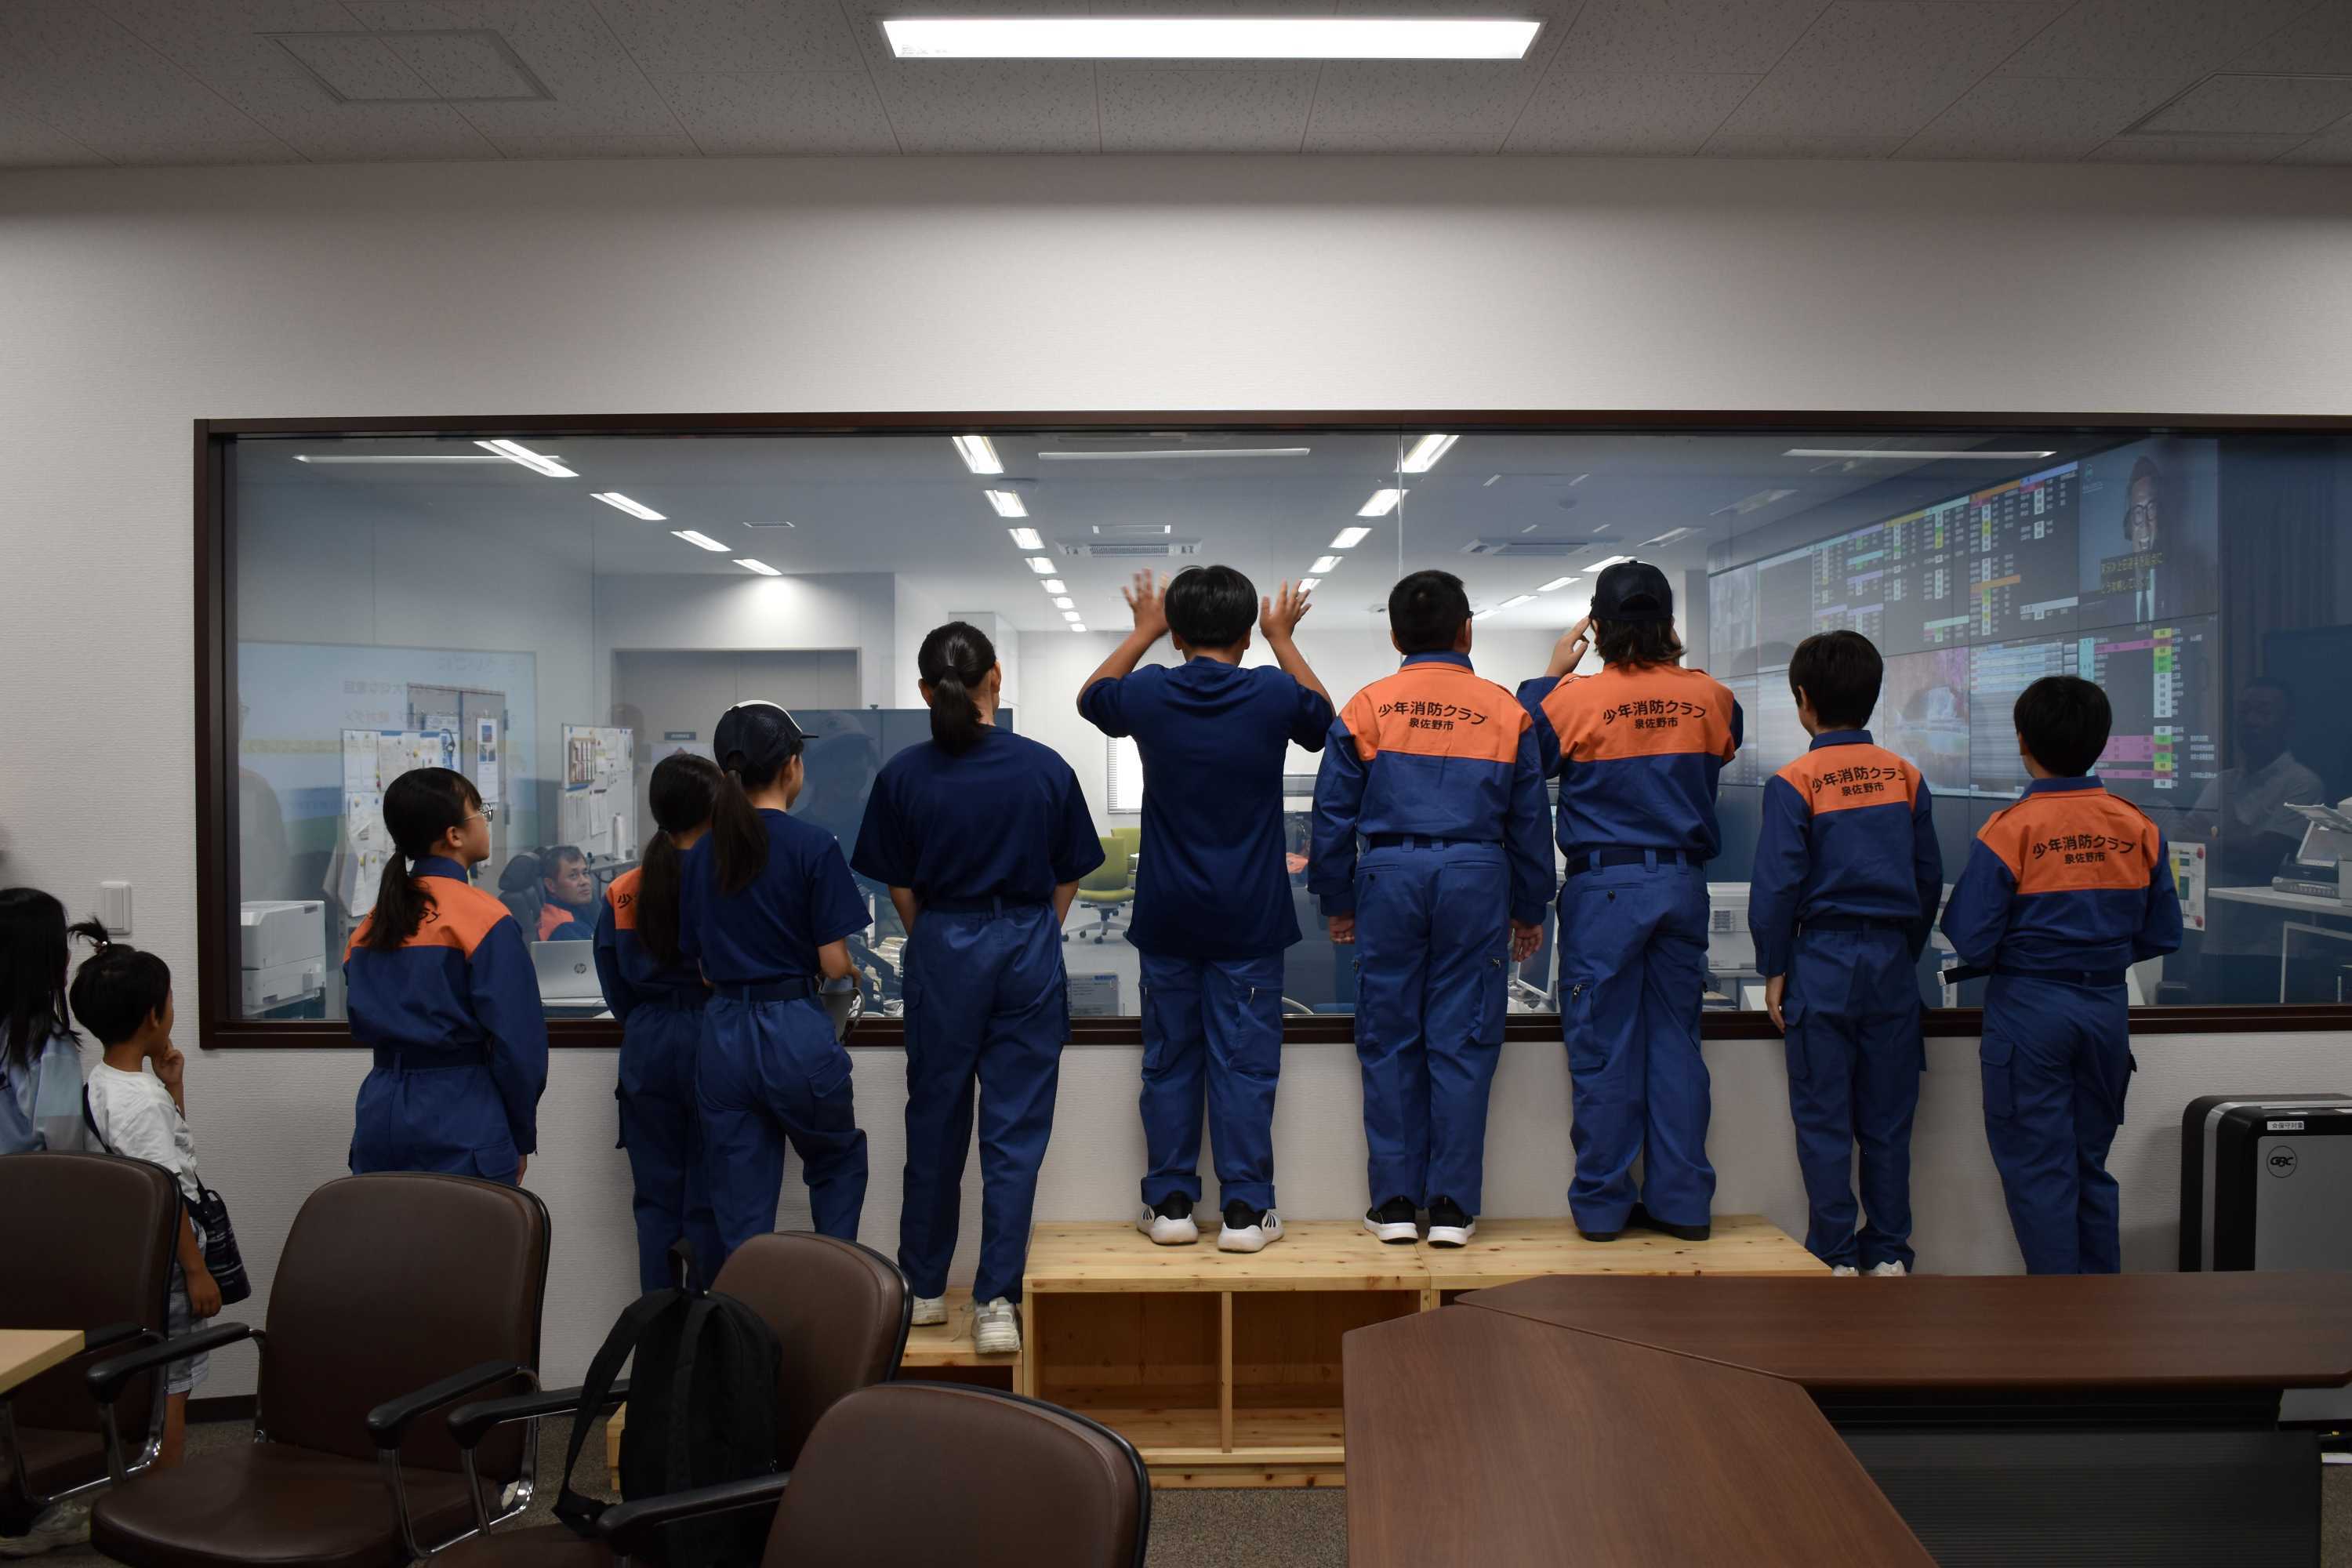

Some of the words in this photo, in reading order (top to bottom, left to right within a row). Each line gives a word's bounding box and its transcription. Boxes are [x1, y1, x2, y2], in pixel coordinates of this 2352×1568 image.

[1377, 701, 1489, 726] 少年消防クラブ
[1602, 699, 1707, 725] 少年消防クラブ
[1408, 717, 1454, 731] 泉佐野市
[1634, 717, 1679, 729] 泉佐野市
[1841, 782, 1885, 797] 泉佐野市
[2032, 833, 2136, 860] 少年消防クラブ
[2064, 851, 2105, 865] 泉佐野市
